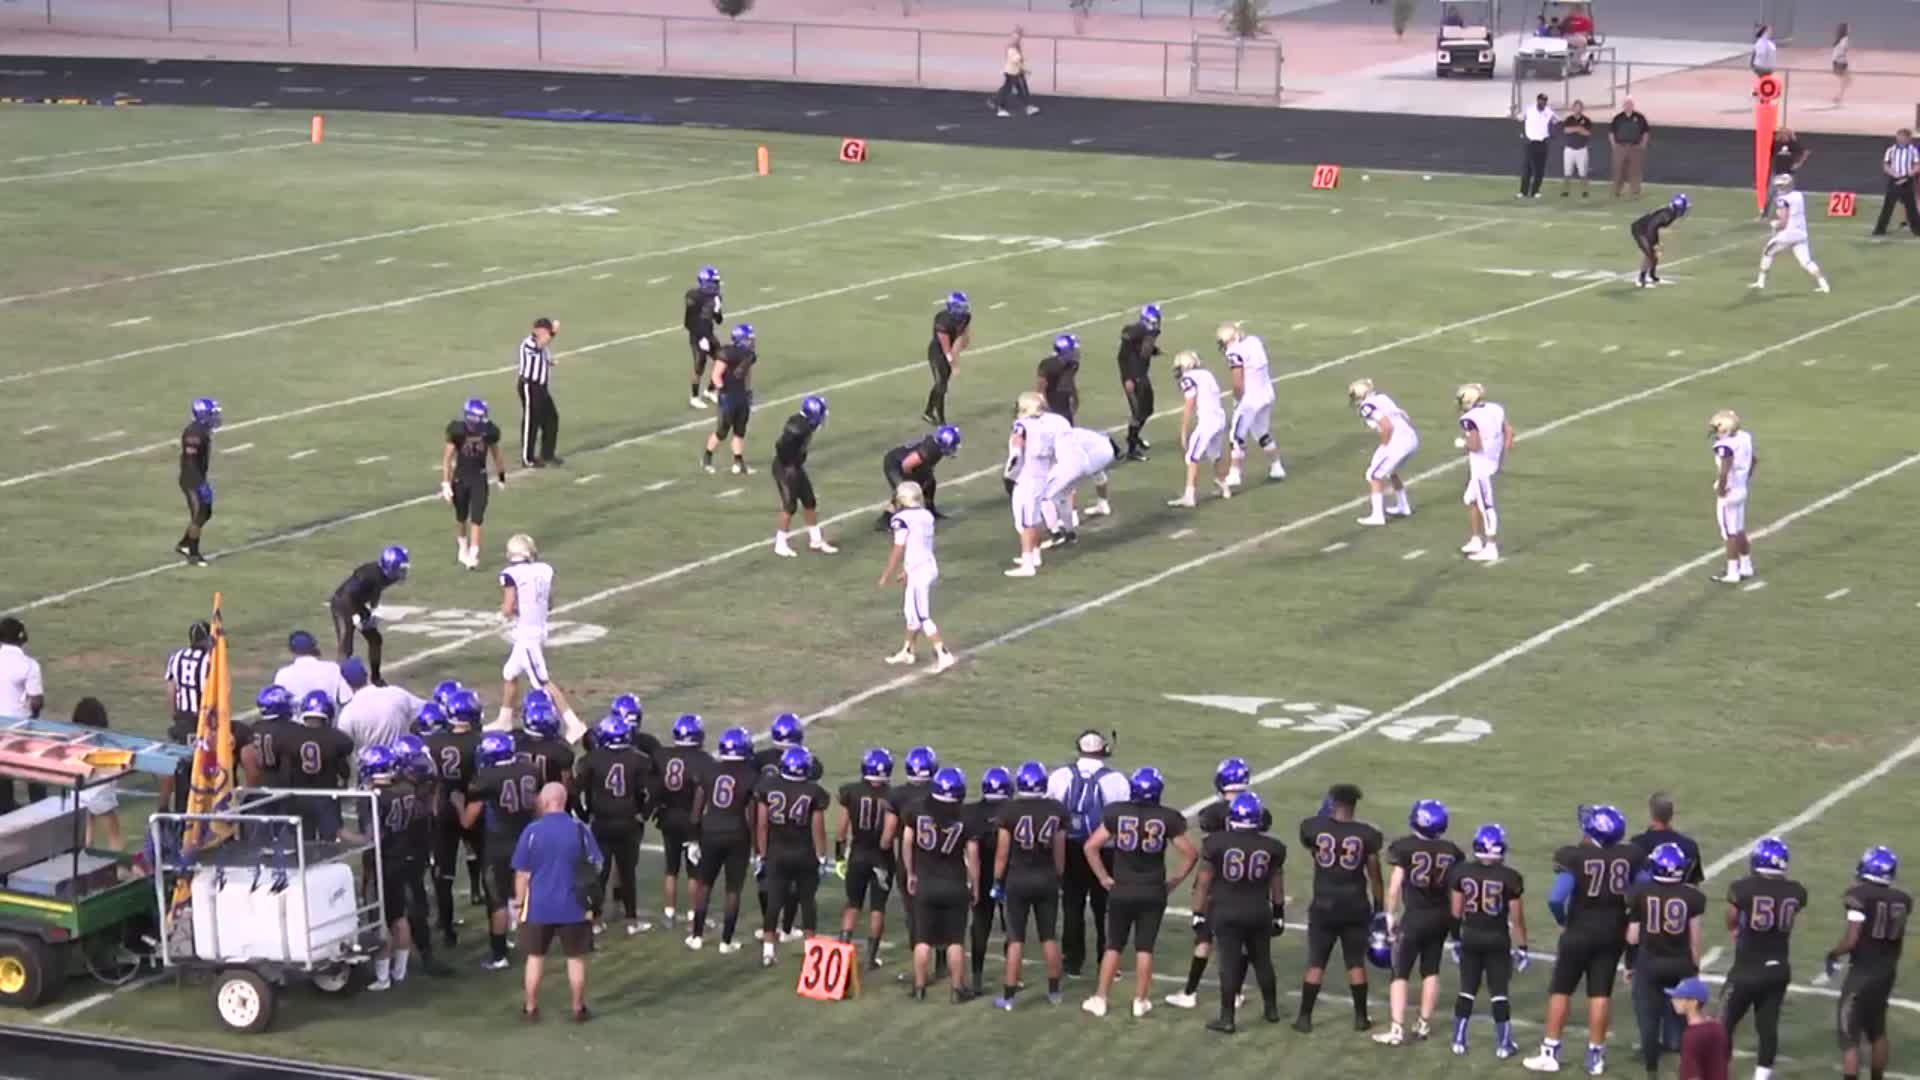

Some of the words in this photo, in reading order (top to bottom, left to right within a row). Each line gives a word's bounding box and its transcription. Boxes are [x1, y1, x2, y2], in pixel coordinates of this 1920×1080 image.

[844, 141, 861, 160] G
[1318, 167, 1334, 187] 10
[1831, 194, 1851, 214] 20
[182, 661, 198, 686] H
[300, 741, 322, 774] 9
[440, 746, 461, 780] 2
[665, 758, 685, 791] 8
[605, 763, 626, 797] 4
[713, 774, 736, 808] 6
[767, 791, 812, 825] 24
[1014, 815, 1060, 850] 44
[1117, 816, 1166, 853] 53
[1223, 848, 1271, 881] 66
[1316, 832, 1363, 870] 33
[1410, 851, 1456, 887] 27
[1584, 858, 1632, 897] 78
[1460, 877, 1504, 914] 25
[1646, 896, 1688, 934] 19
[805, 945, 843, 993] 30
